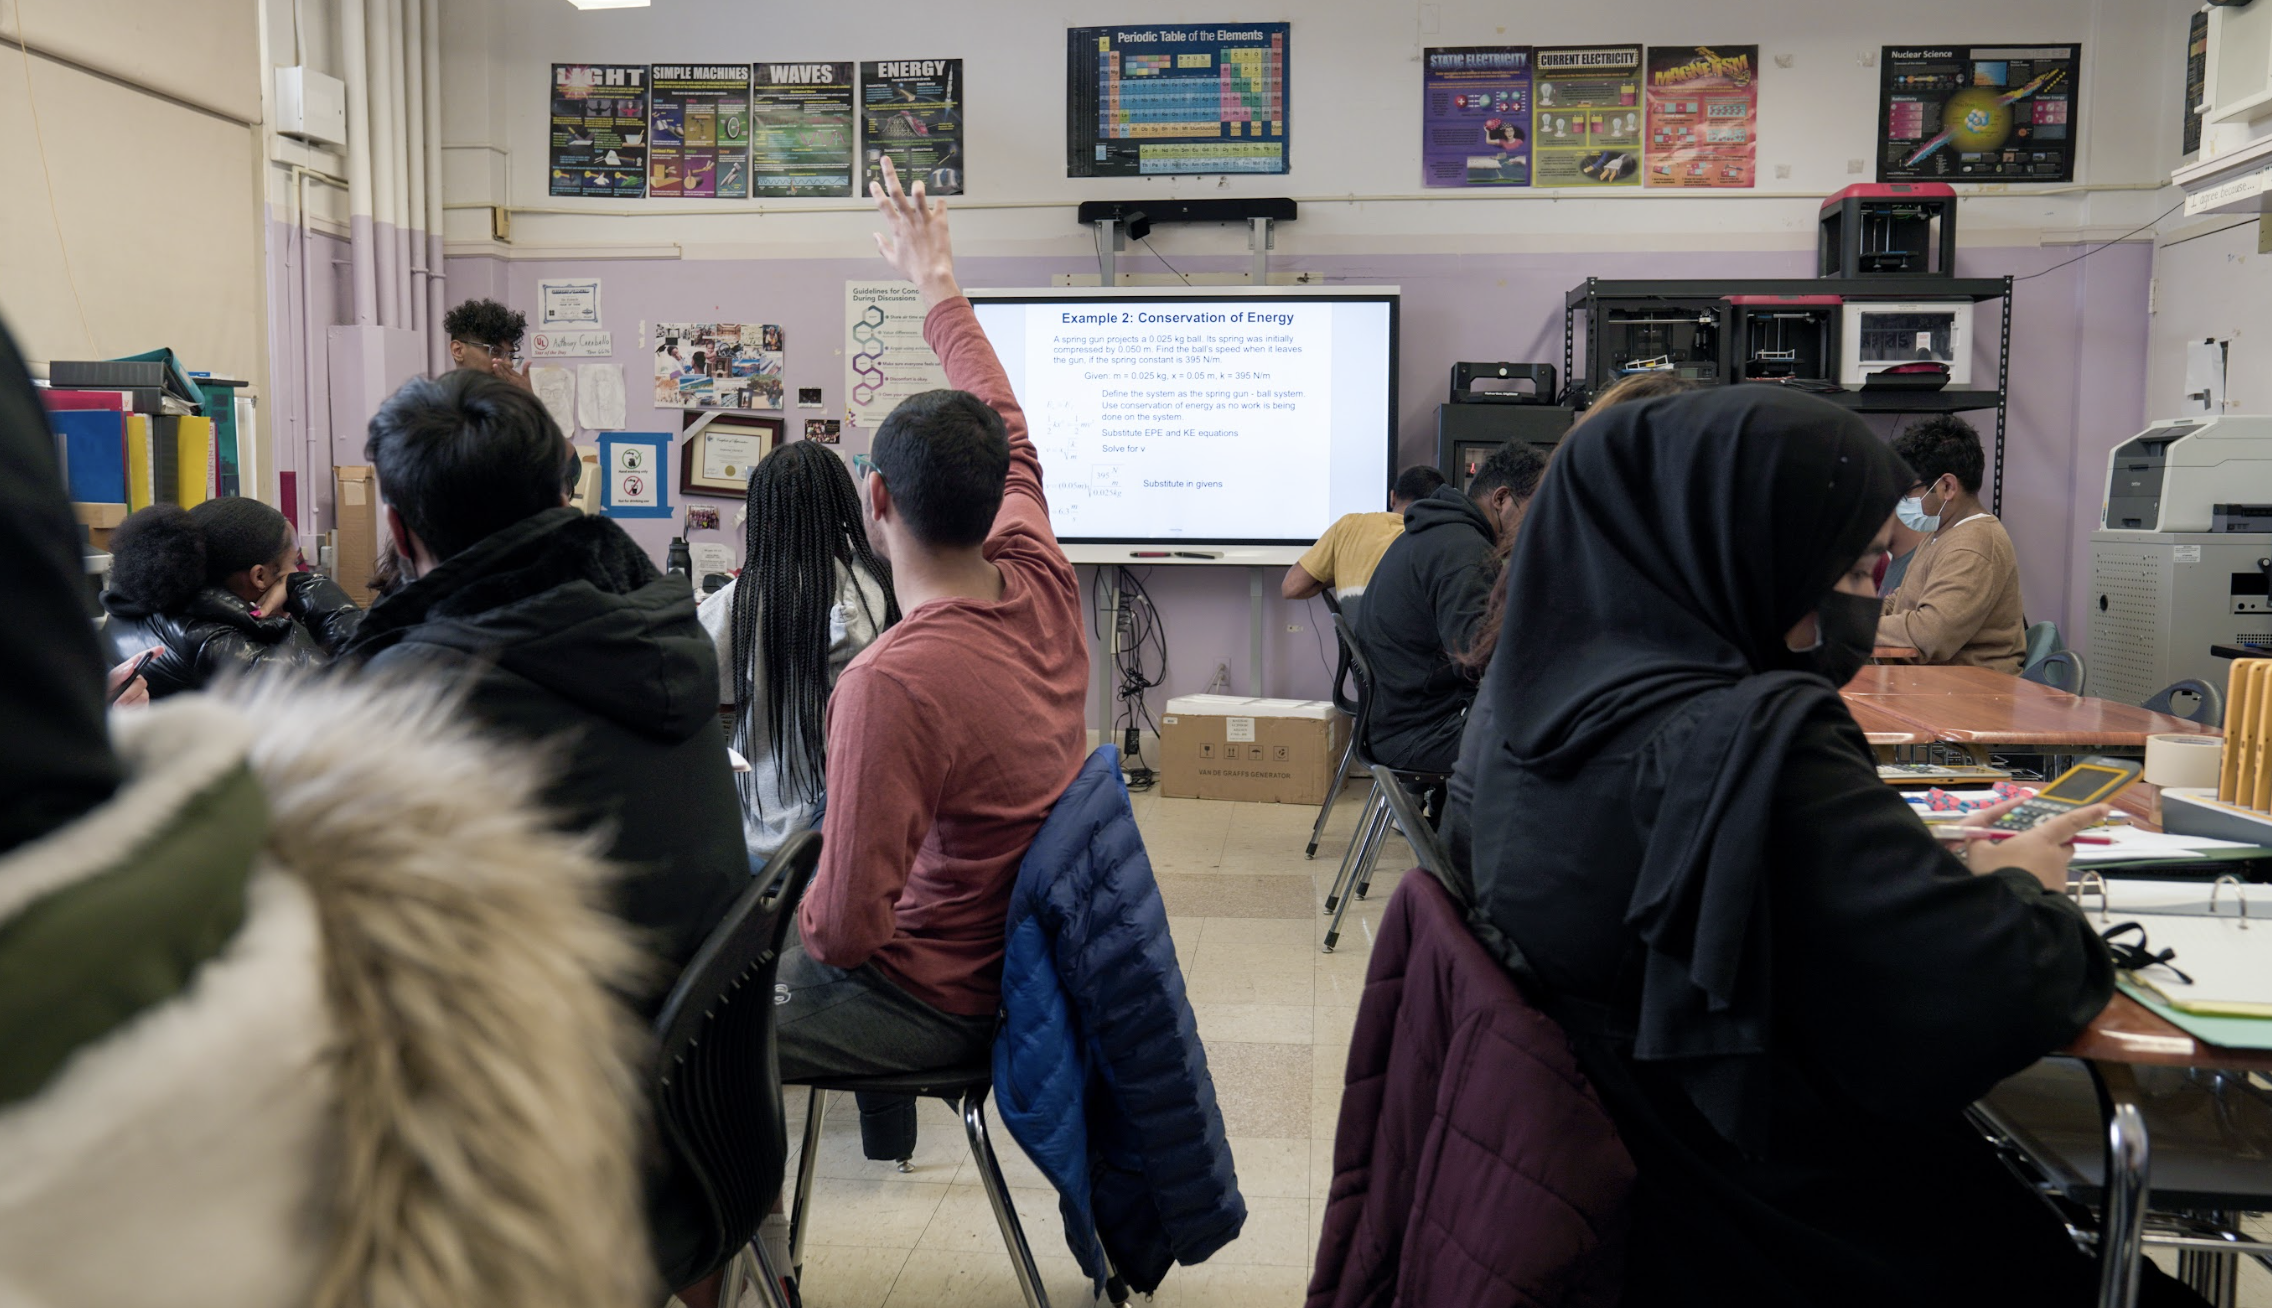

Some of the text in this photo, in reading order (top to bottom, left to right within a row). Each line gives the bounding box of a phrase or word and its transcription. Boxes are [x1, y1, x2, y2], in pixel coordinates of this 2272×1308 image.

[1117, 30, 1264, 43] Periodic Table of the Elements
[1430, 53, 1527, 67] STATIC ELECTRICITY
[1541, 52, 1635, 66] CURRENT ELECTRICITY
[1891, 50, 1952, 59] Nuclear Science
[653, 66, 749, 80] SIMPLE MACHINES
[769, 64, 833, 84] WAVES
[878, 60, 946, 78] ENERGY
[557, 67, 645, 86] LIGHT
[2200, 190, 2218, 209] agree
[853, 287, 888, 295] Guidelines
[1062, 311, 1294, 326] Example 2: Conservation of Energy
[1053, 335, 1060, 343] A
[1062, 335, 1087, 345] spring
[1088, 337, 1105, 345] gun
[1107, 335, 1139, 345] projects
[1149, 335, 1173, 343] 0.025
[1174, 335, 1185, 345] kg
[1186, 335, 1203, 343] ball.
[1206, 335, 1217, 343] Its
[1218, 335, 1244, 345] spring
[1265, 335, 1294, 345] initially
[1053, 345, 1103, 355] compressed
[1105, 345, 1116, 355] by
[1118, 345, 1142, 353] 0.050
[1156, 345, 1174, 353] Find
[1176, 345, 1190, 353] the
[1191, 345, 1213, 353] ball's
[1215, 345, 1241, 355] speed
[1243, 345, 1266, 353] when
[1268, 345, 1273, 353] it
[1275, 345, 1303, 353] leaves
[1053, 355, 1222, 366] the gun, if the spring constant is 395 N/m.
[1084, 371, 1110, 380] Given:
[1131, 371, 1155, 380] 0.025
[1156, 372, 1169, 382] kg,
[1186, 371, 1205, 380] 0.05
[1235, 371, 1251, 380] 395
[1253, 371, 1271, 380] N/m
[1102, 389, 1129, 398] Define
[1130, 389, 1144, 398] the
[1146, 389, 1175, 400] system
[1189, 389, 1203, 398] the
[1205, 389, 1231, 400] spring
[1232, 391, 1249, 400] gun
[1256, 389, 1272, 398] ball
[1273, 389, 1305, 400] system.
[1102, 401, 1118, 410] Use
[1120, 401, 1173, 410] conservation
[1175, 401, 1184, 410] of
[1185, 403, 1214, 412] energy
[1240, 401, 1261, 410] work
[1263, 401, 1271, 410] is
[1272, 401, 1296, 412] being
[1101, 413, 1122, 421] done
[1137, 413, 1150, 421] the
[1152, 413, 1184, 423] system.
[1102, 428, 1239, 439] Substitute EPE and KE equations
[1102, 444, 1125, 453] Solve
[1127, 444, 1139, 453] for
[1143, 479, 1223, 490] Substitute in givens
[1250, 771, 1291, 779] GENERATOR
